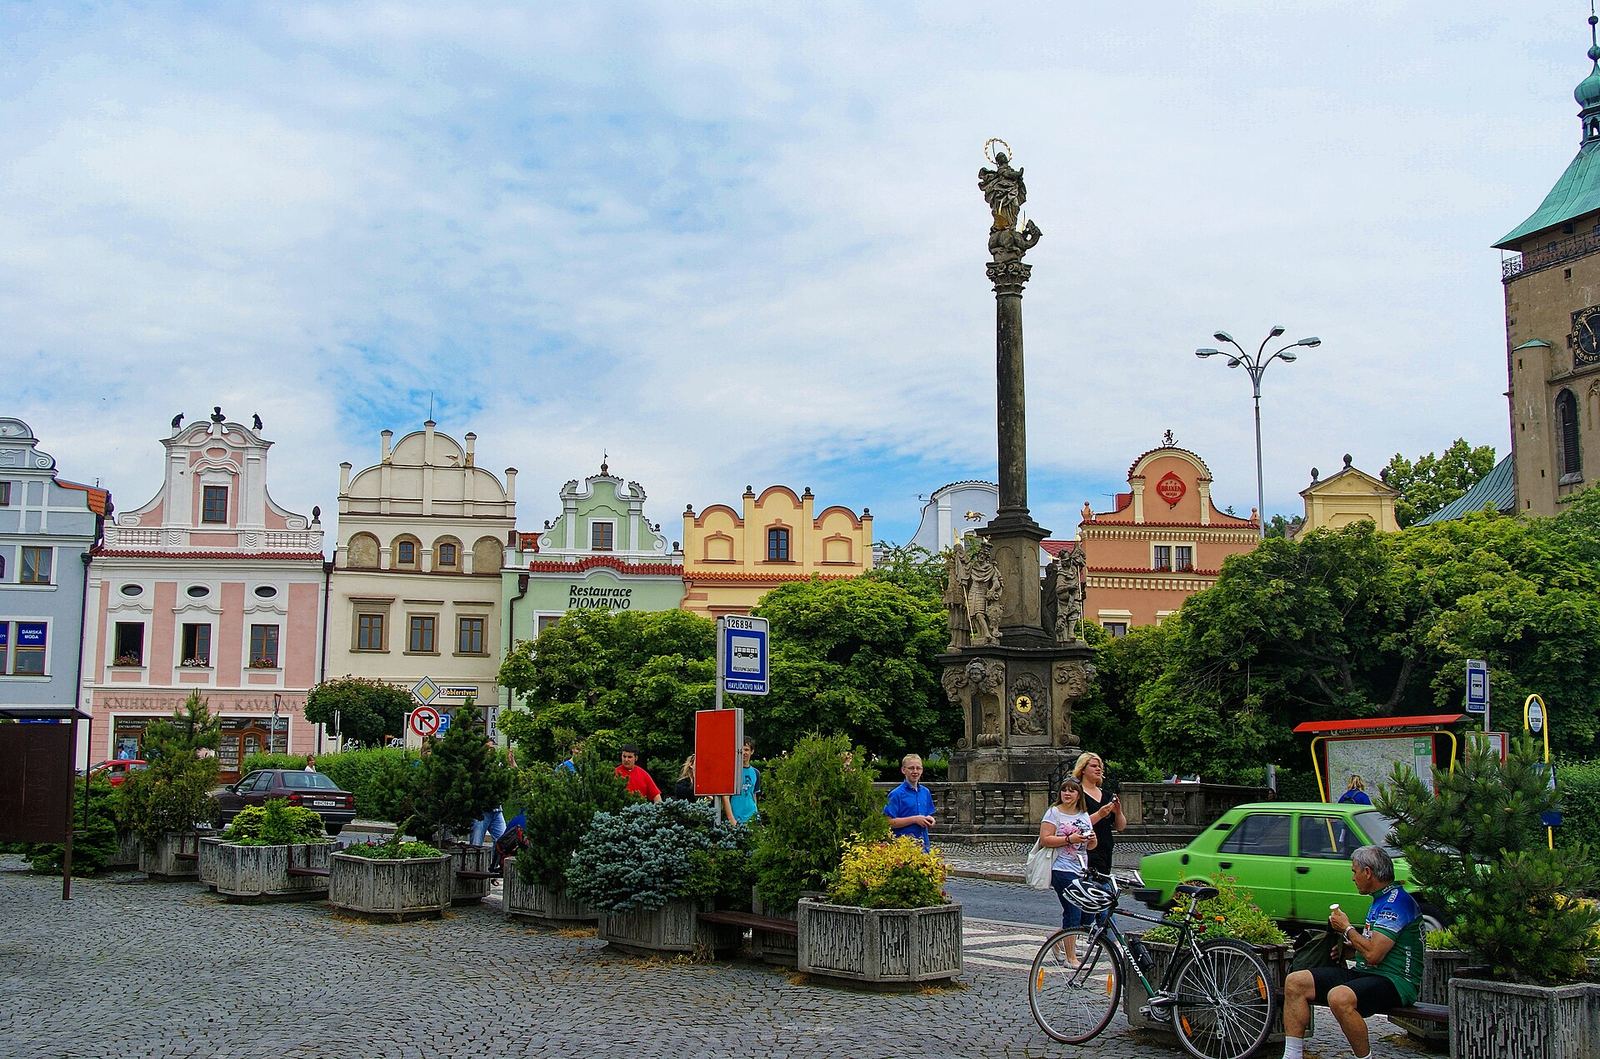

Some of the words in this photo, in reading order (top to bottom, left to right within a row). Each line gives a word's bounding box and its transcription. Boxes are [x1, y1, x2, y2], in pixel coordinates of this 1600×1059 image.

[569, 585, 632, 597] Restaurace
[568, 597, 631, 609] PIOMBINO
[727, 619, 753, 629] 126894
[235, 694, 300, 711] KAVÁNA
[1122, 945, 1143, 978] AUTHOR
